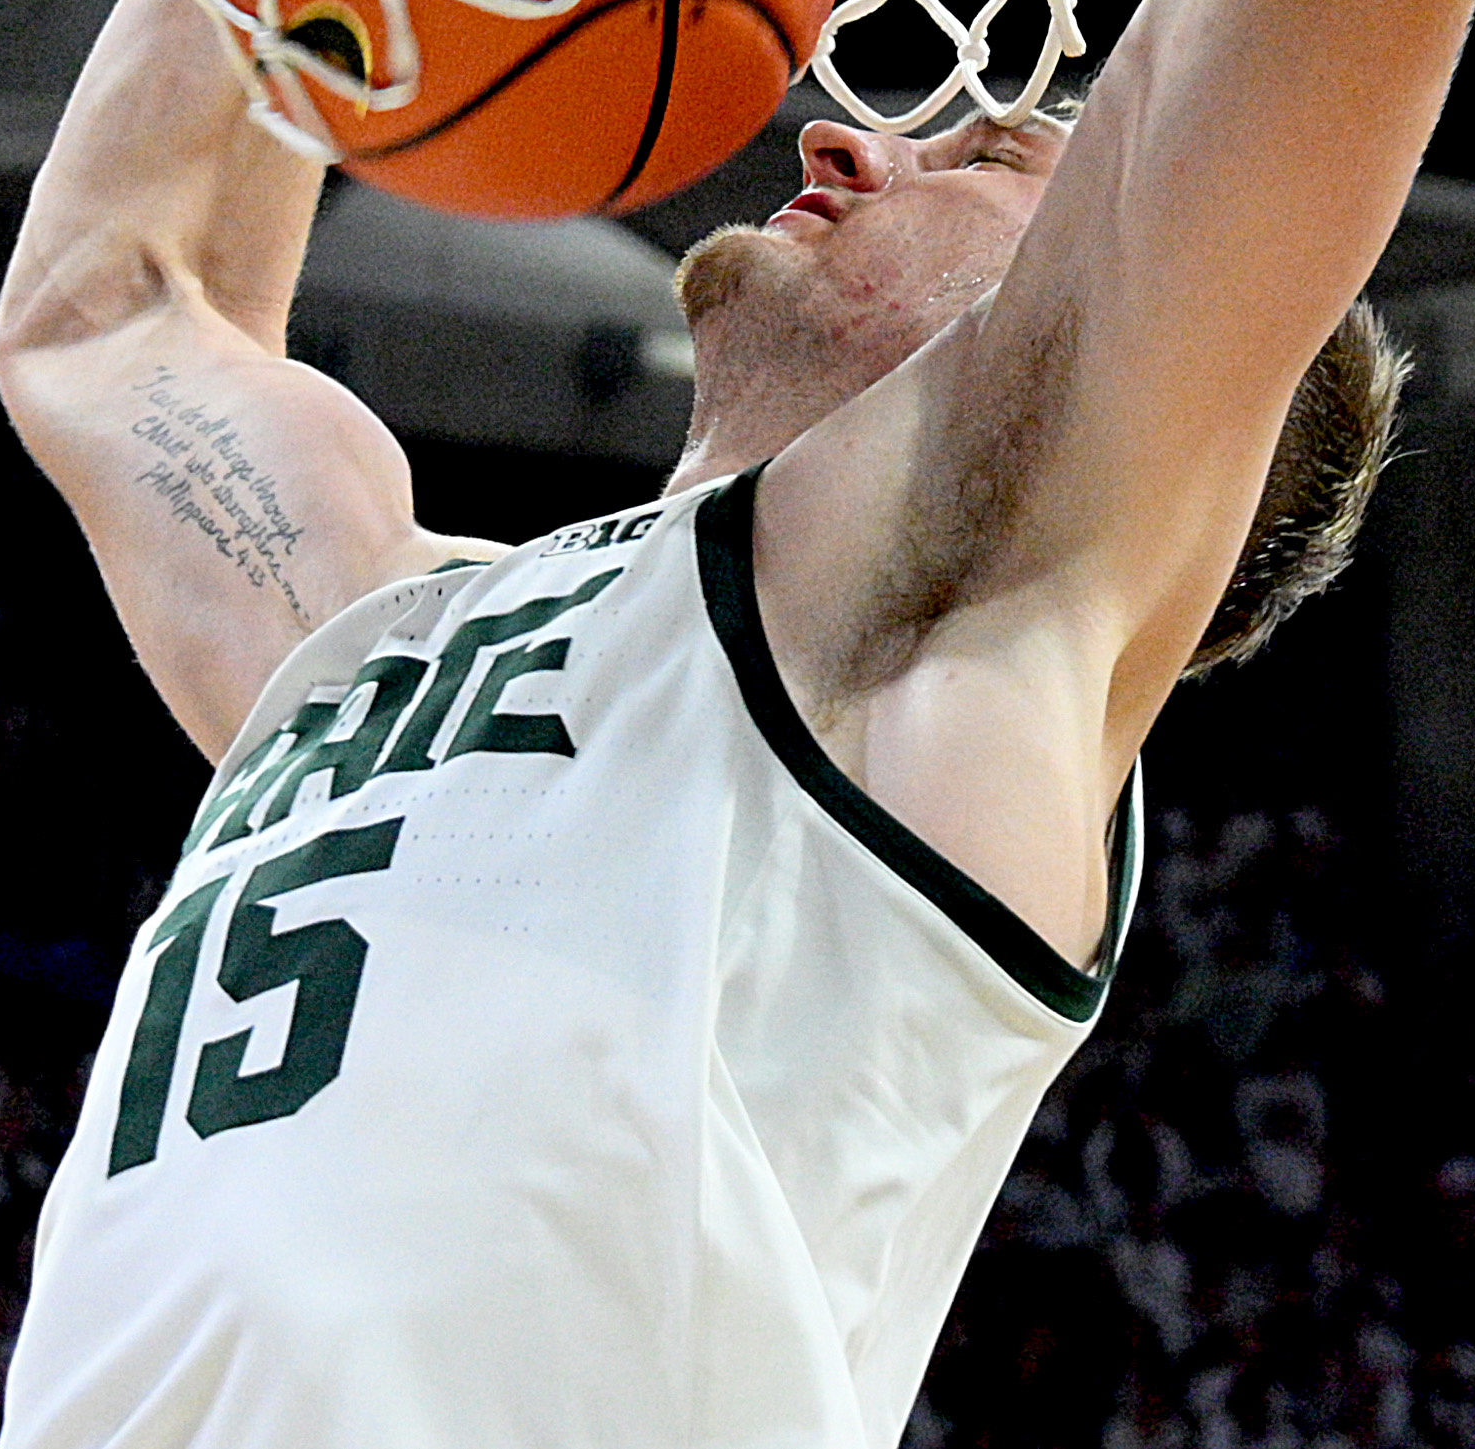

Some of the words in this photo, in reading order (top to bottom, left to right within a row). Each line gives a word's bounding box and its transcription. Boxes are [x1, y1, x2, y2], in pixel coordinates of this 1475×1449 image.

[178, 404, 207, 425] do
[196, 417, 229, 437] all
[185, 454, 215, 485] who
[211, 432, 254, 482] things
[249, 474, 305, 556] through
[107, 815, 405, 1180] 15
